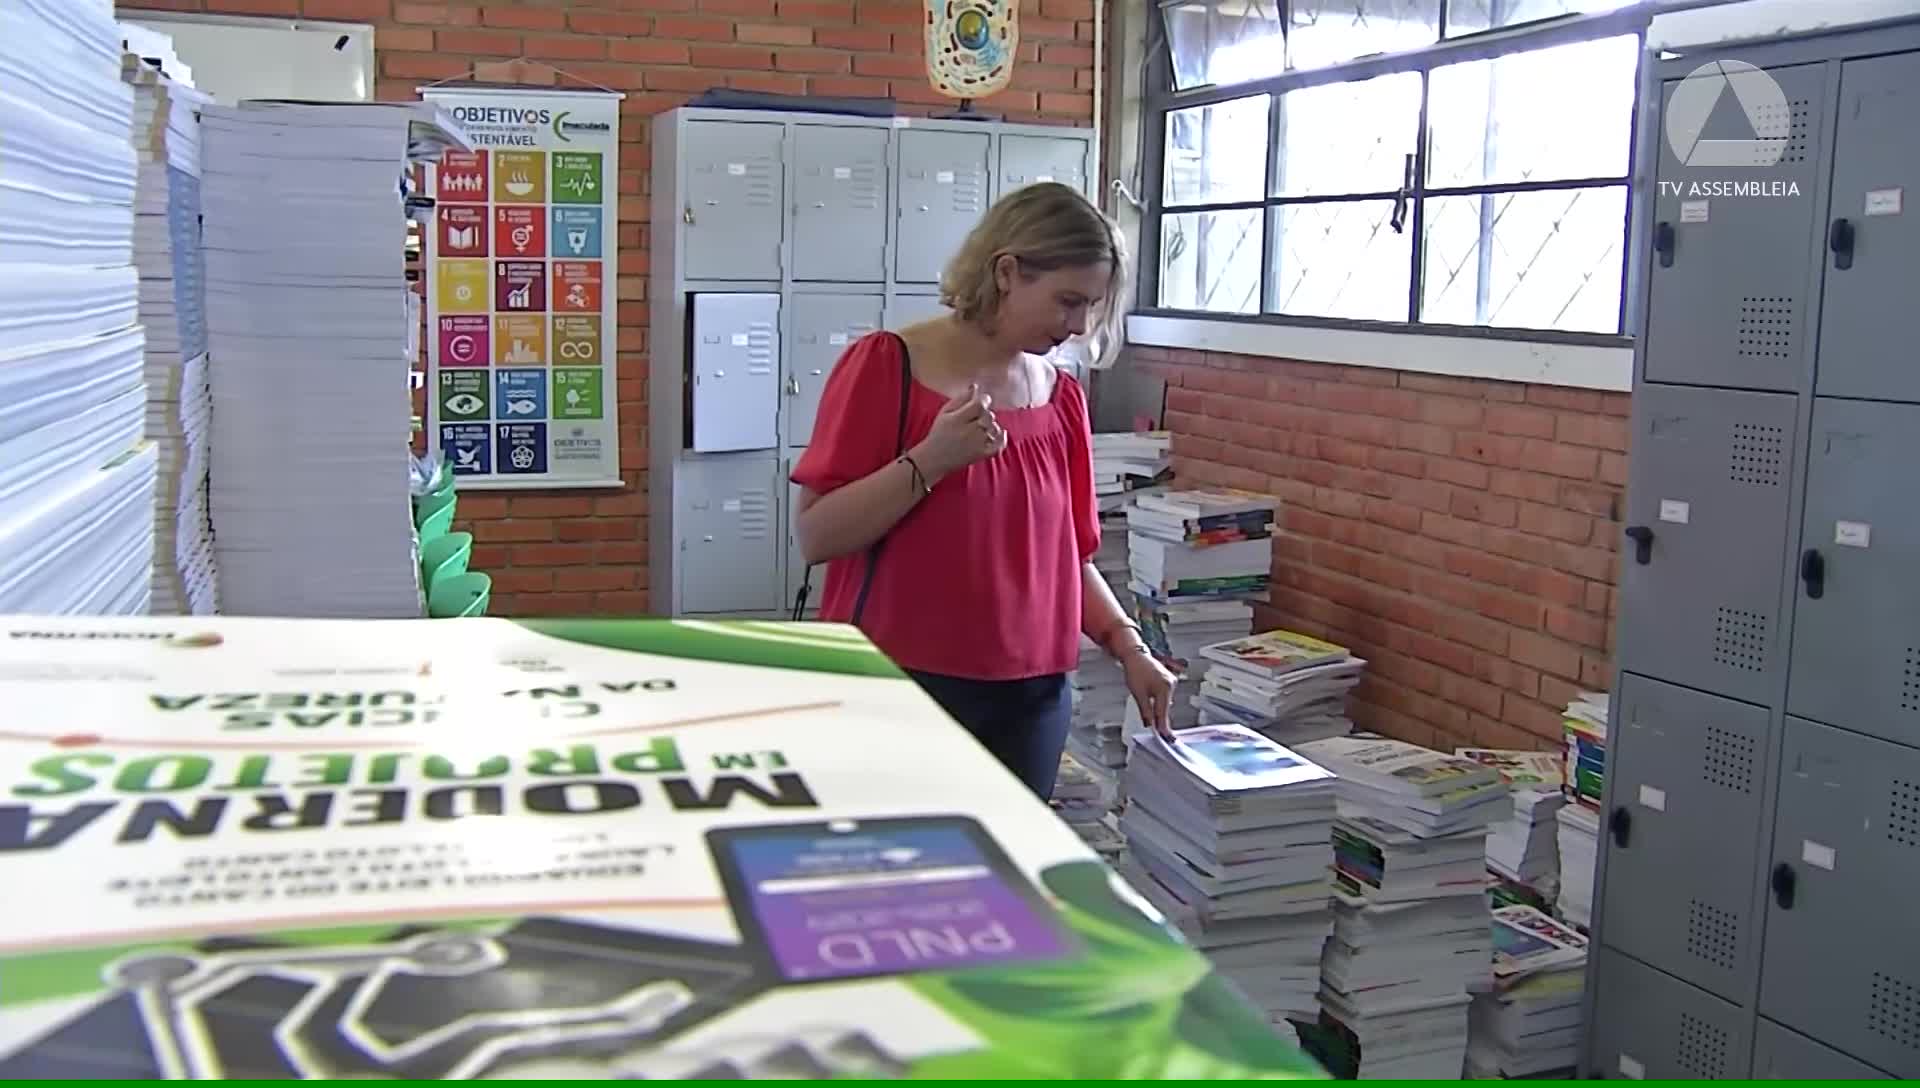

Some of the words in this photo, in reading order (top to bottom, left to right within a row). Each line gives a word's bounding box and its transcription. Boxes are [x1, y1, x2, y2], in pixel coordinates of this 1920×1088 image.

[452, 106, 550, 125] OBJETIVOS
[468, 133, 537, 146] STENTÁVEL
[556, 156, 564, 168] 3
[441, 208, 449, 221] 4
[499, 209, 507, 222] 5
[441, 319, 453, 331] 10
[441, 372, 453, 385] 13
[499, 372, 510, 385] 14
[555, 372, 567, 384] 15
[443, 427, 454, 440] 16
[499, 426, 510, 439] 17
[600, 678, 678, 692] DA
[11, 736, 687, 797] PROJETOS
[711, 750, 790, 770] EM
[0, 771, 820, 853] MODERNA
[817, 919, 1016, 969] PNLD
